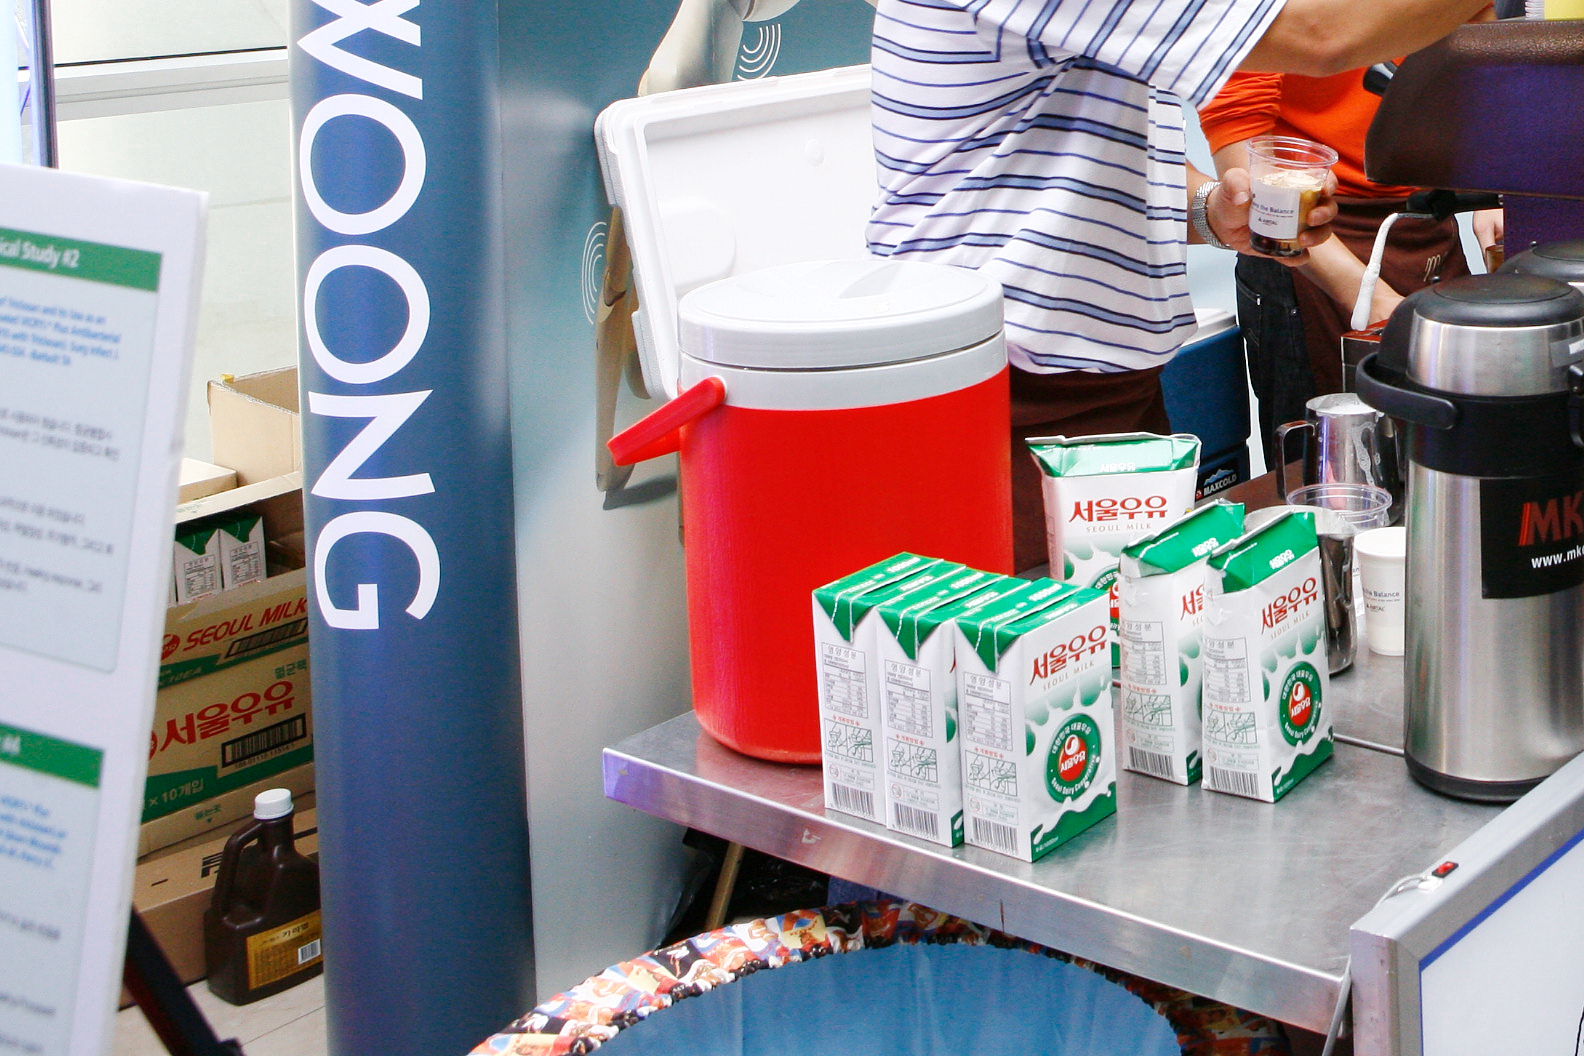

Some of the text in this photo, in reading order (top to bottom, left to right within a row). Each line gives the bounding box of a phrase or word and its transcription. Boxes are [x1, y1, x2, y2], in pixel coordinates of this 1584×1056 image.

[1069, 495, 1168, 523] 서울우유
[1086, 524, 1120, 532] SEOUL
[183, 597, 308, 652] SEOUL MILK
[1261, 577, 1319, 636] 서울우유
[1030, 625, 1107, 685] 서울우유
[160, 680, 295, 752] 서울우유
